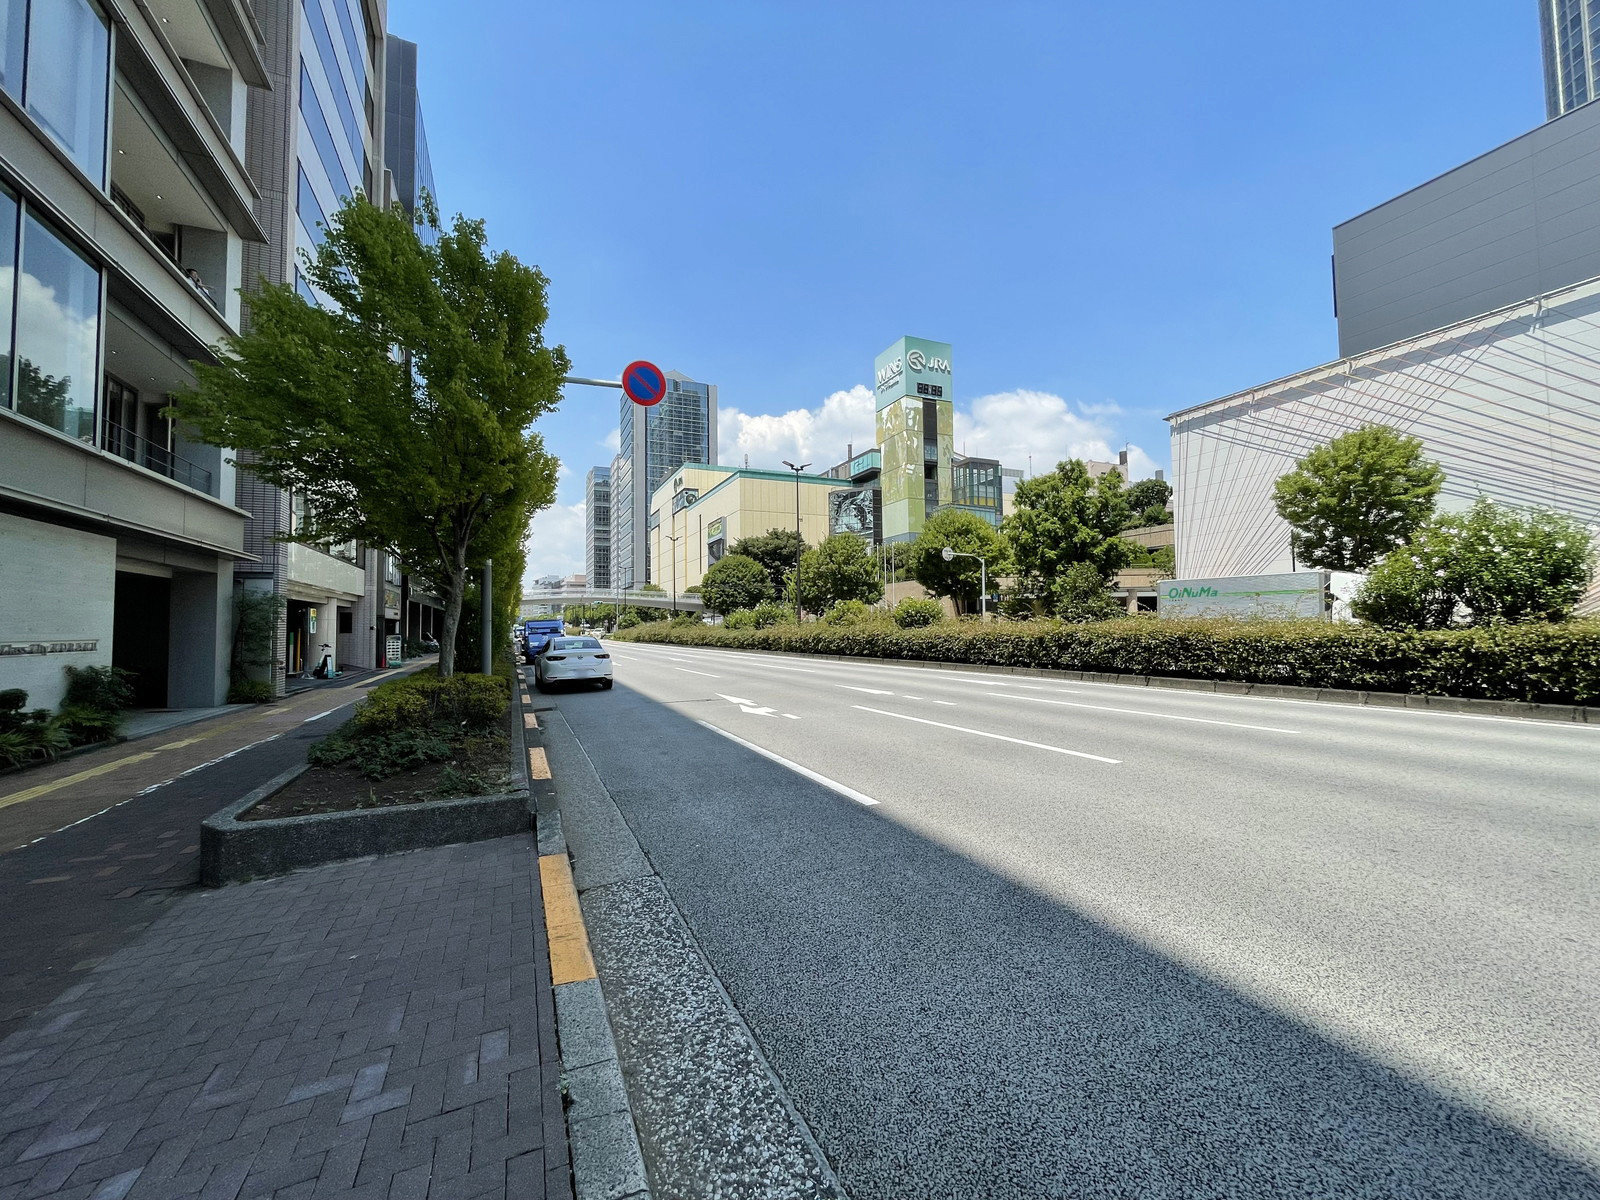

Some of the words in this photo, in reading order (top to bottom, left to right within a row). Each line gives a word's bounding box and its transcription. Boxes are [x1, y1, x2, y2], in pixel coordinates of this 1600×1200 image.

[877, 356, 903, 384] WINS
[928, 357, 950, 371] JRA
[1168, 586, 1219, 599] OiNuMa
